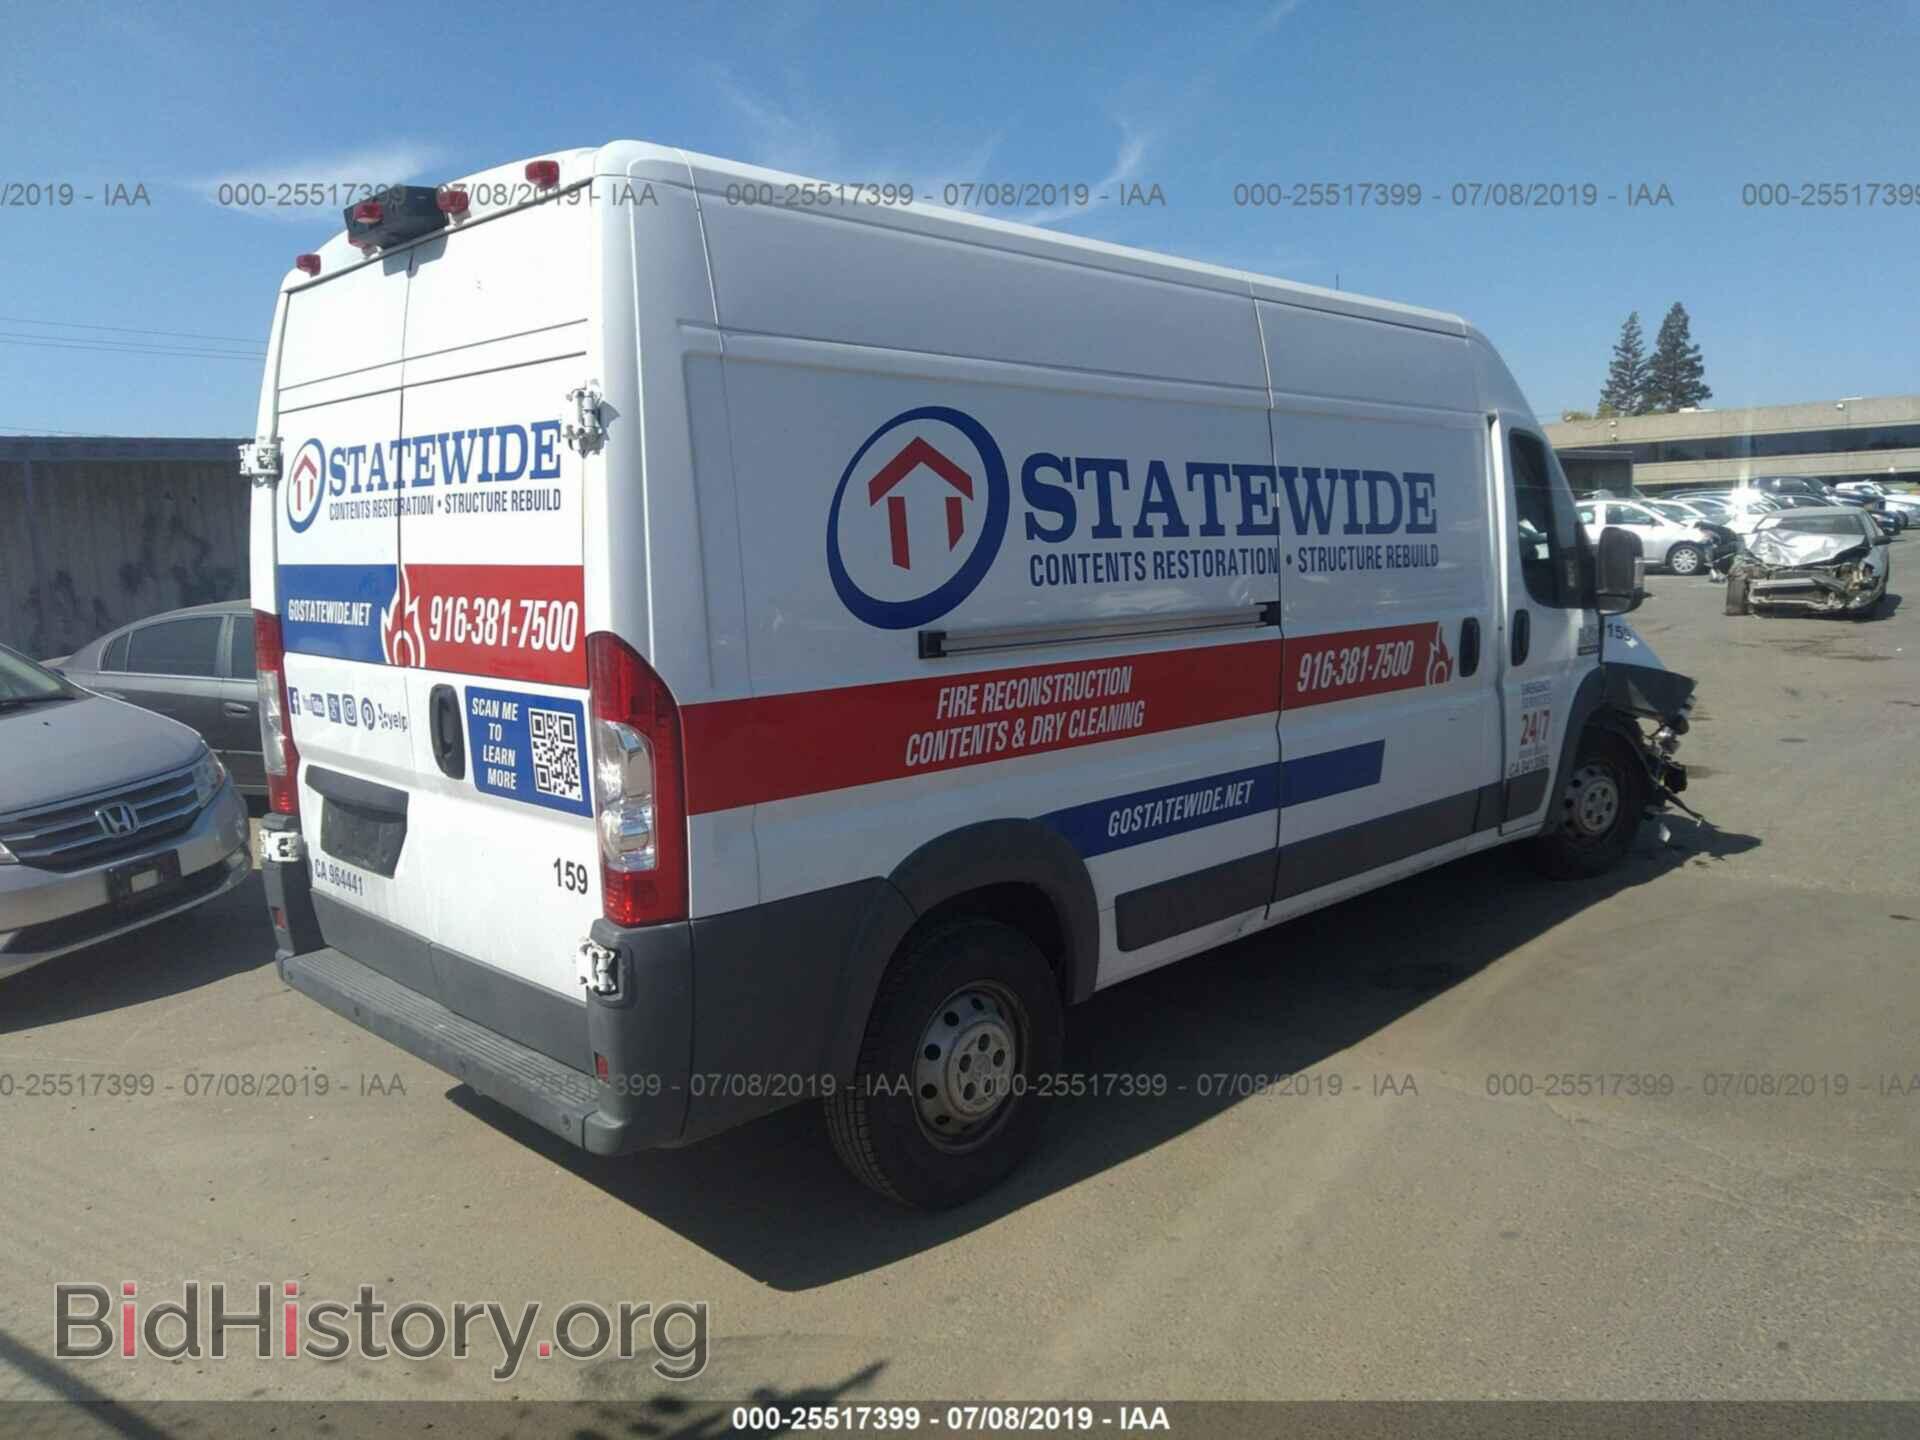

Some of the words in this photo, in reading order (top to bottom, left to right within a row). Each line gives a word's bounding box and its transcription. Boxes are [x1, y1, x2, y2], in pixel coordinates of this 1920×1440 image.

[328, 419, 562, 498] STATEWIDE
[329, 500, 371, 521] CONTENTS
[372, 495, 435, 519] RESTORATION
[444, 490, 509, 514] STRUCTURE
[510, 488, 562, 512] REBUILD
[1020, 451, 1438, 544] STATEWIDE
[1029, 550, 1147, 587] CONTENTS
[1152, 547, 1280, 581] RESTORATION
[1297, 544, 1383, 573] STRUCTURE
[1385, 543, 1440, 569] REBUILD
[288, 598, 372, 627] GOSTATEWIDE.NET
[429, 595, 579, 654] 916-381-7500
[1296, 639, 1416, 694] 916-381-7500
[471, 696, 501, 719] SCAN
[501, 701, 519, 722] ME
[935, 686, 978, 721] FIRE
[981, 665, 1134, 717] RECONSTRUCTION
[488, 722, 503, 741] TO
[904, 720, 1009, 768] CONTENTS
[1011, 721, 1027, 749] &
[1030, 711, 1068, 746] DRY
[1067, 700, 1146, 740] CLEANING
[482, 745, 517, 767] LEARN
[487, 771, 518, 791] MORE
[1106, 779, 1255, 838] GOSTATEWIDE.NET
[314, 858, 328, 881] CA
[552, 857, 589, 895] 159
